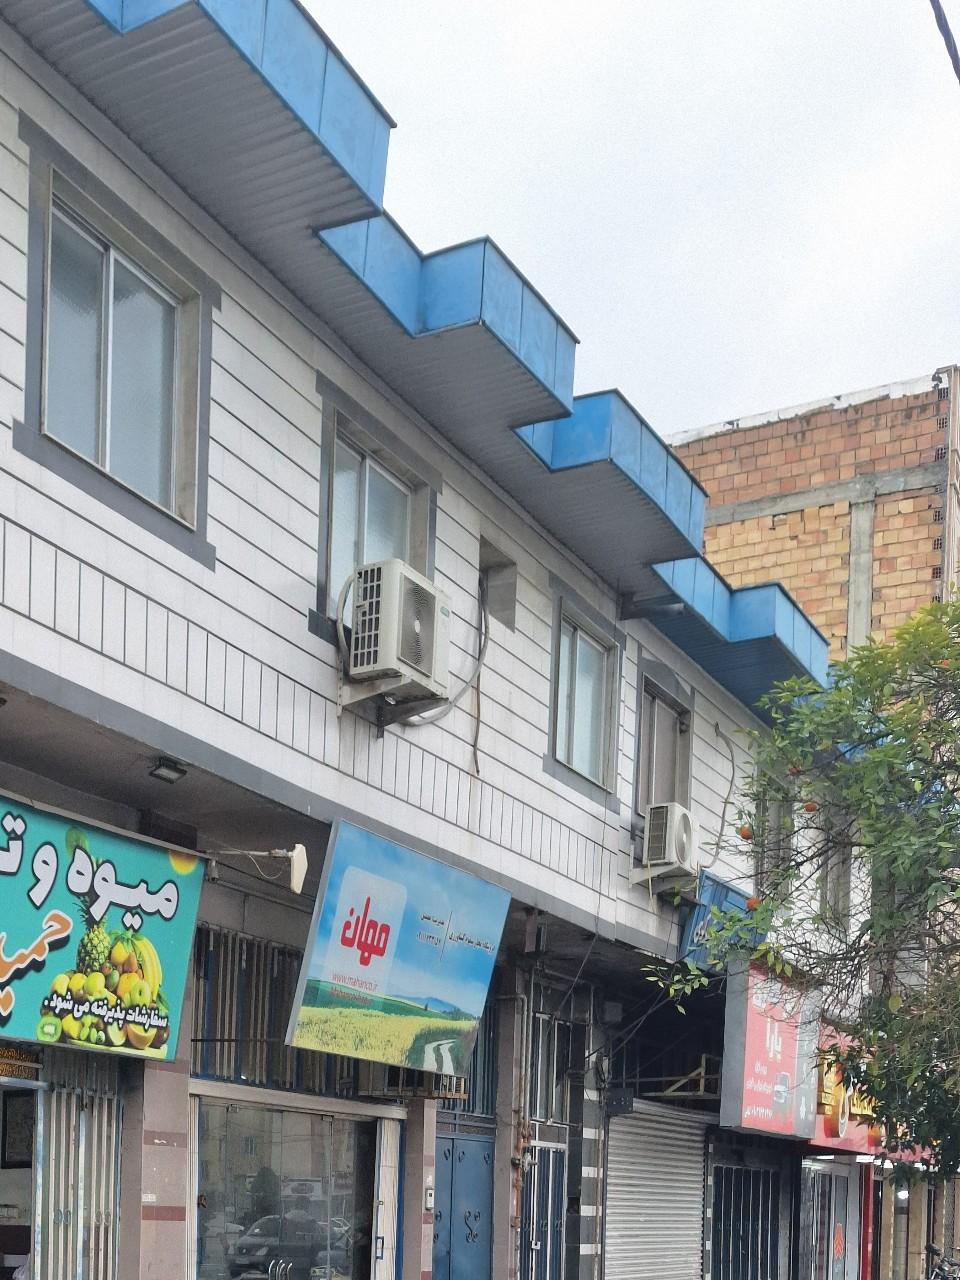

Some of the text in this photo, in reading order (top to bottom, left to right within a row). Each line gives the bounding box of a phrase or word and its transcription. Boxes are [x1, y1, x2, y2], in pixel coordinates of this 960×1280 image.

[28, 840, 58, 906] و
[66, 849, 179, 928] میوه
[73, 1002, 90, 1018] می
[91, 999, 125, 1028] پذیرفته
[125, 1005, 168, 1030] سفارشات
